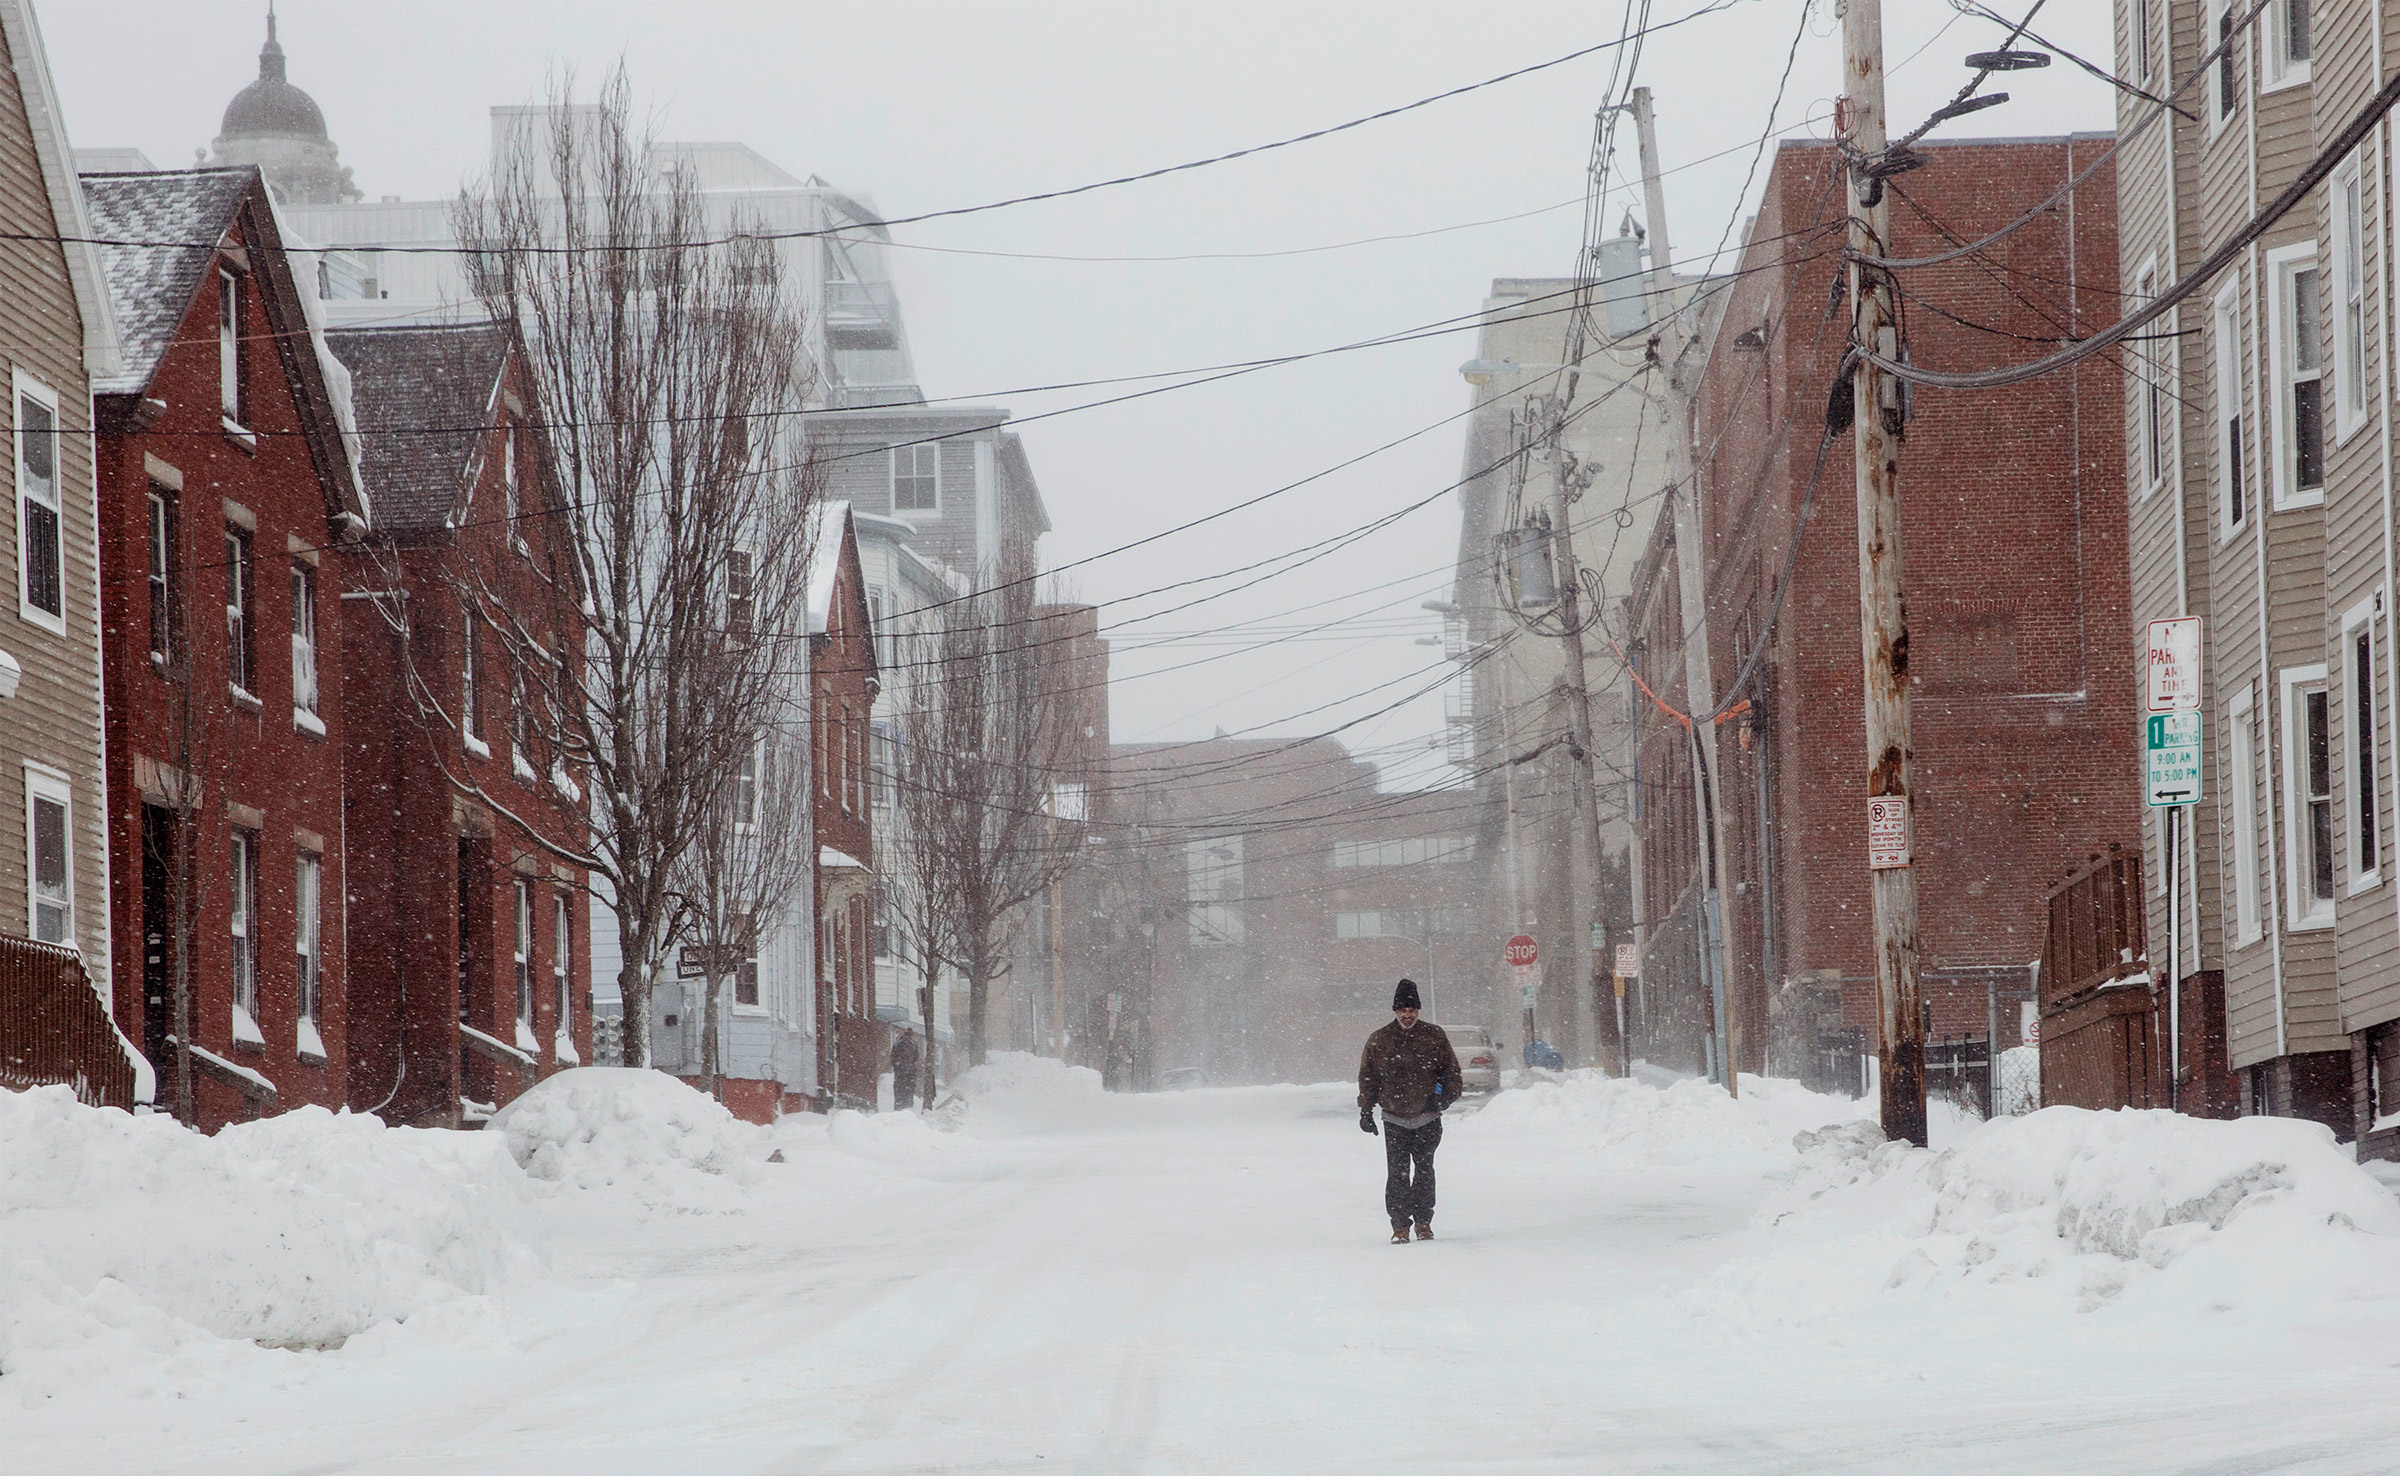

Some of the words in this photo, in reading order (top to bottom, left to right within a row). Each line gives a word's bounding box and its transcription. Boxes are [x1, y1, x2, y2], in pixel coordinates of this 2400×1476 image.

[2157, 753, 2176, 765] 9:00
[2180, 752, 2191, 763] AM
[2152, 771, 2161, 782] TO
[2165, 769, 2183, 781] 5:00
[2187, 768, 2197, 779] PM
[1507, 944, 1537, 960] STOP
